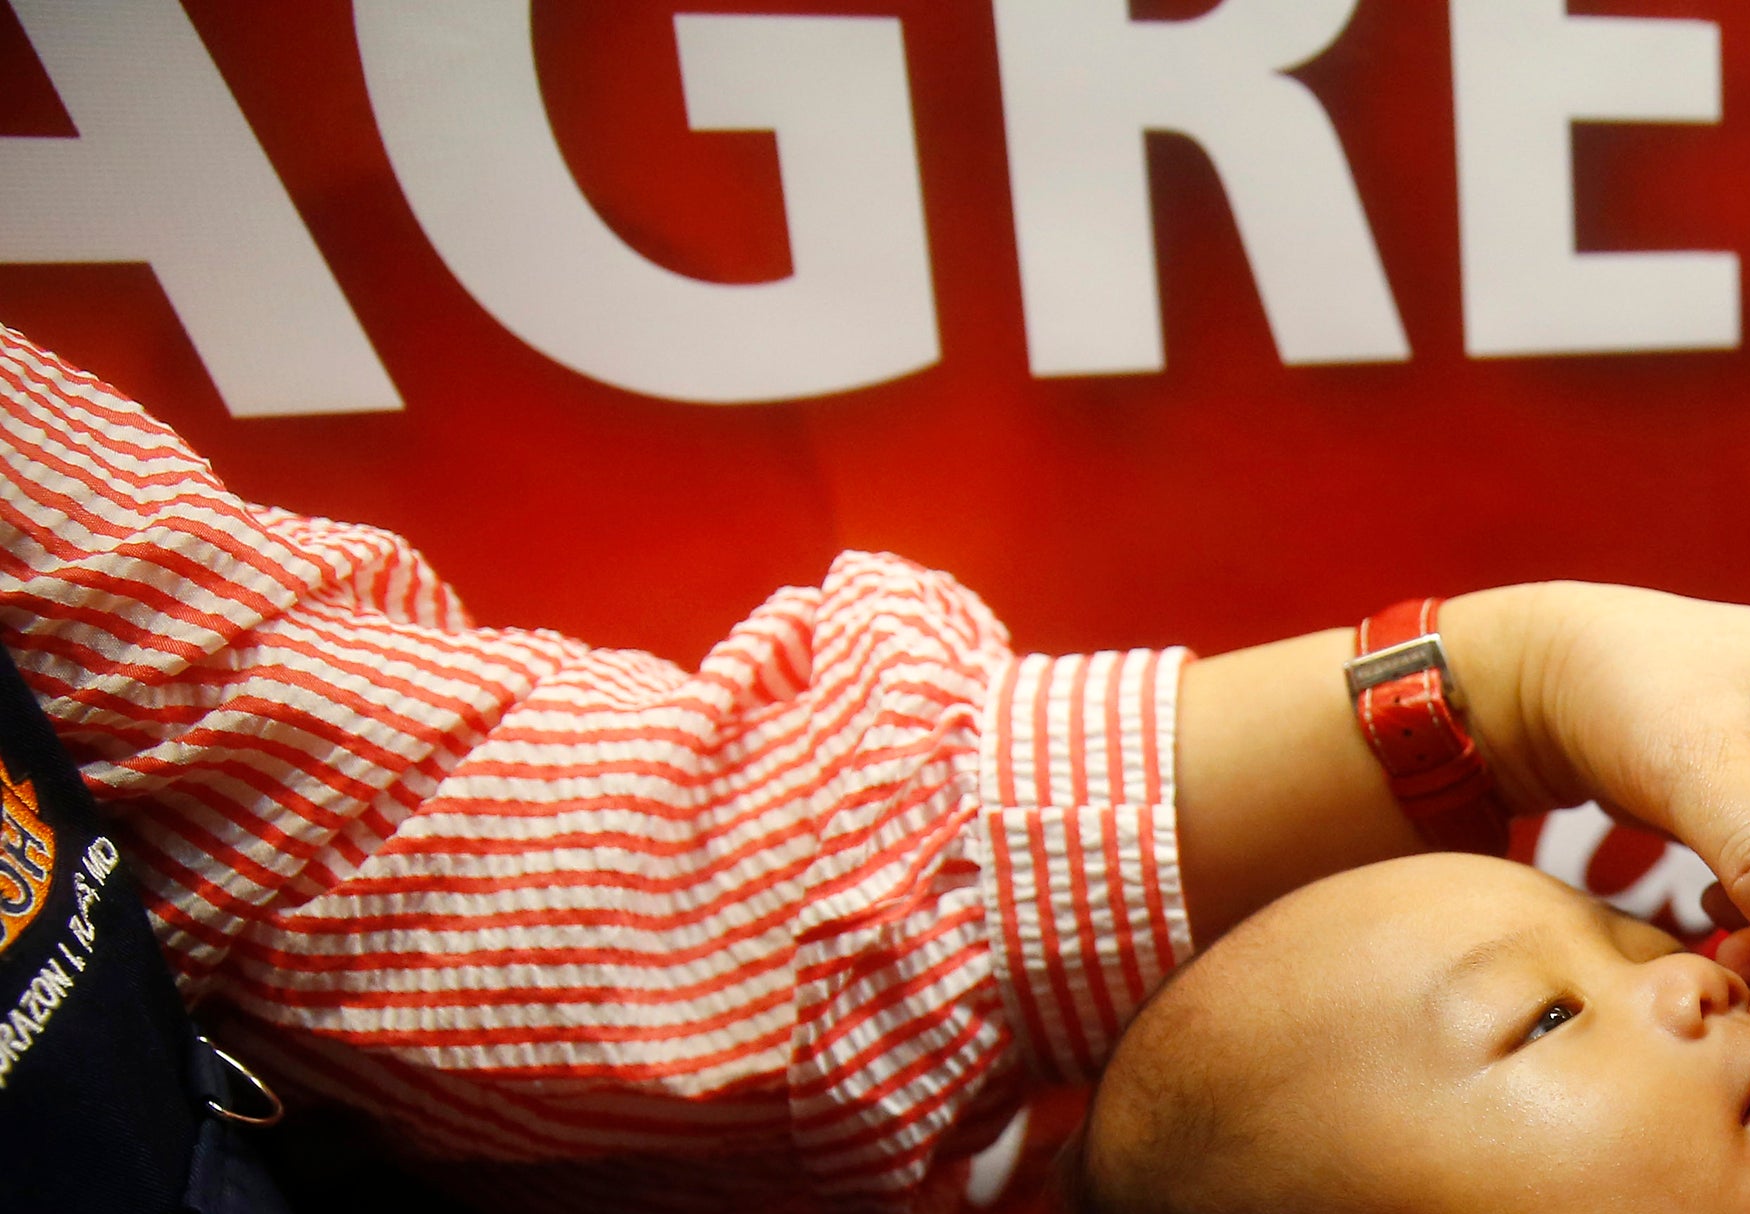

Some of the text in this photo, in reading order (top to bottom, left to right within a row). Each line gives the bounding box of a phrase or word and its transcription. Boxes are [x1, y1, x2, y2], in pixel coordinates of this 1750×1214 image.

[0, 802, 52, 946] OH
[0, 957, 74, 1091] RAZON
[82, 836, 119, 886] MD
